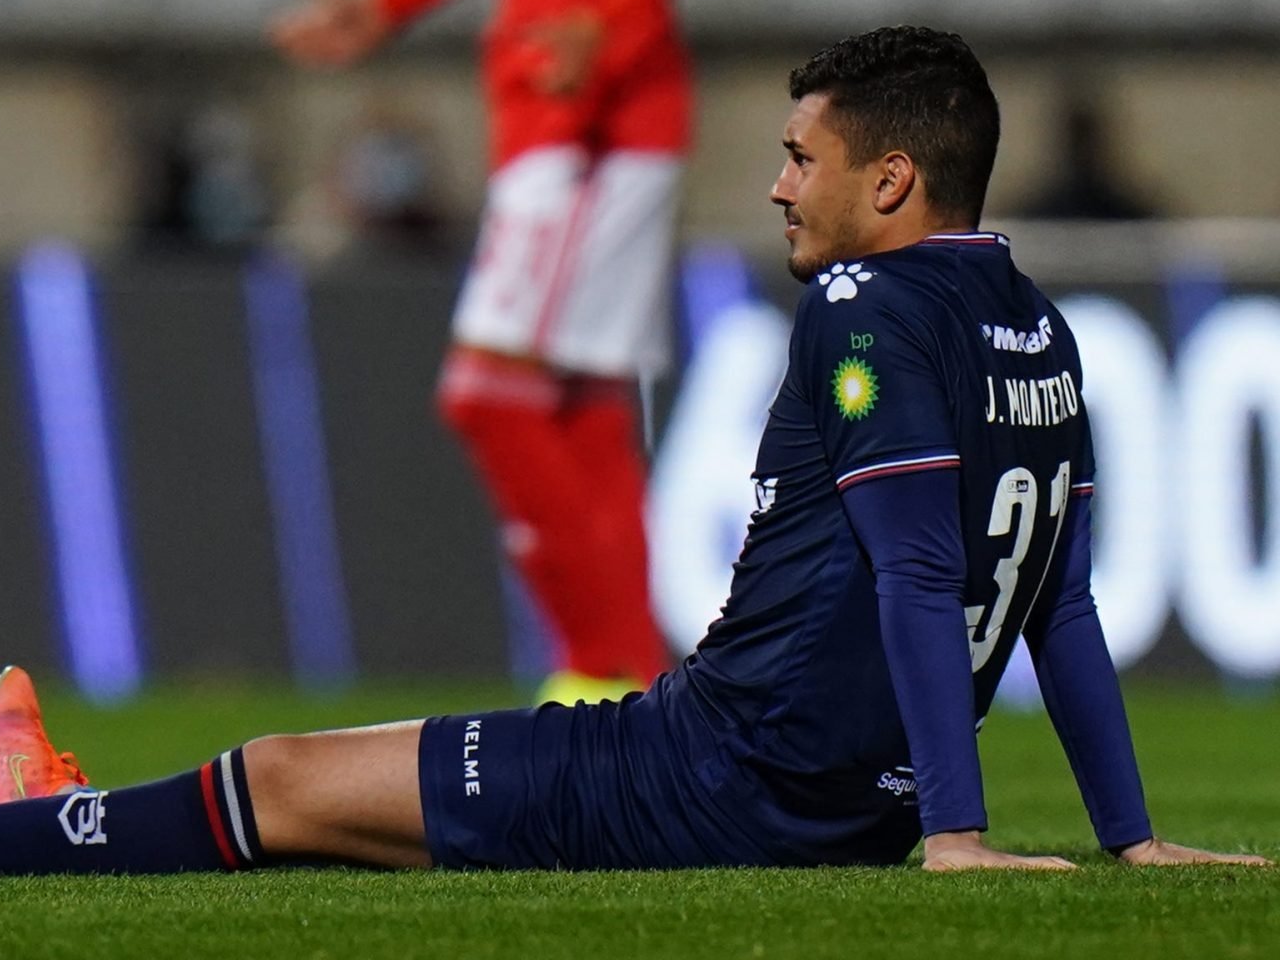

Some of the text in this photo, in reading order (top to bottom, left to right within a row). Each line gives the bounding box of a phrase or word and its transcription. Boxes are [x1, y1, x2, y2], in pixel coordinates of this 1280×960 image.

[850, 331, 874, 352] bp
[964, 461, 1070, 674] 31
[463, 719, 482, 797] KELME
